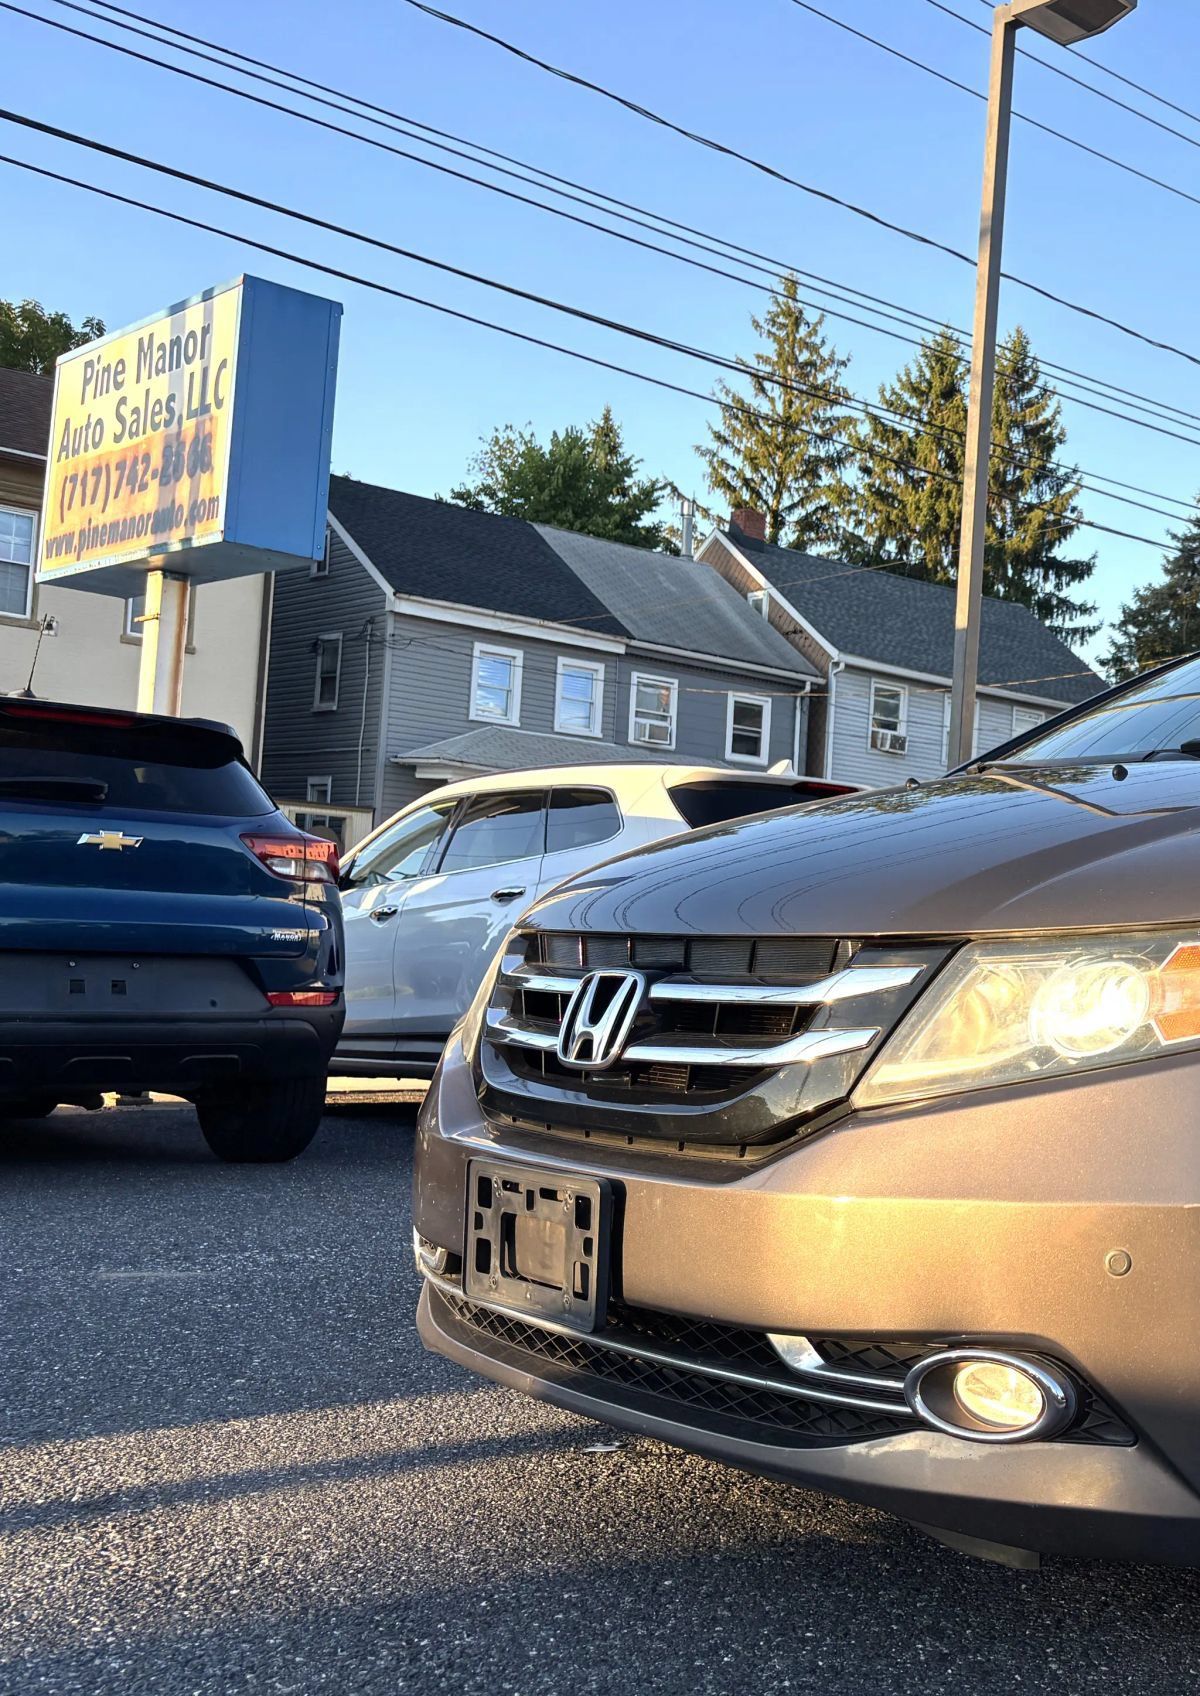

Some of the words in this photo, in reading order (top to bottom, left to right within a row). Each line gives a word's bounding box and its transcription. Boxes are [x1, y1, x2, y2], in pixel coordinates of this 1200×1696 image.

[80, 354, 126, 405] Pine
[136, 323, 210, 384] Manor
[57, 416, 104, 462] Auto
[45, 496, 219, 561] www.pinemanorauto.com
